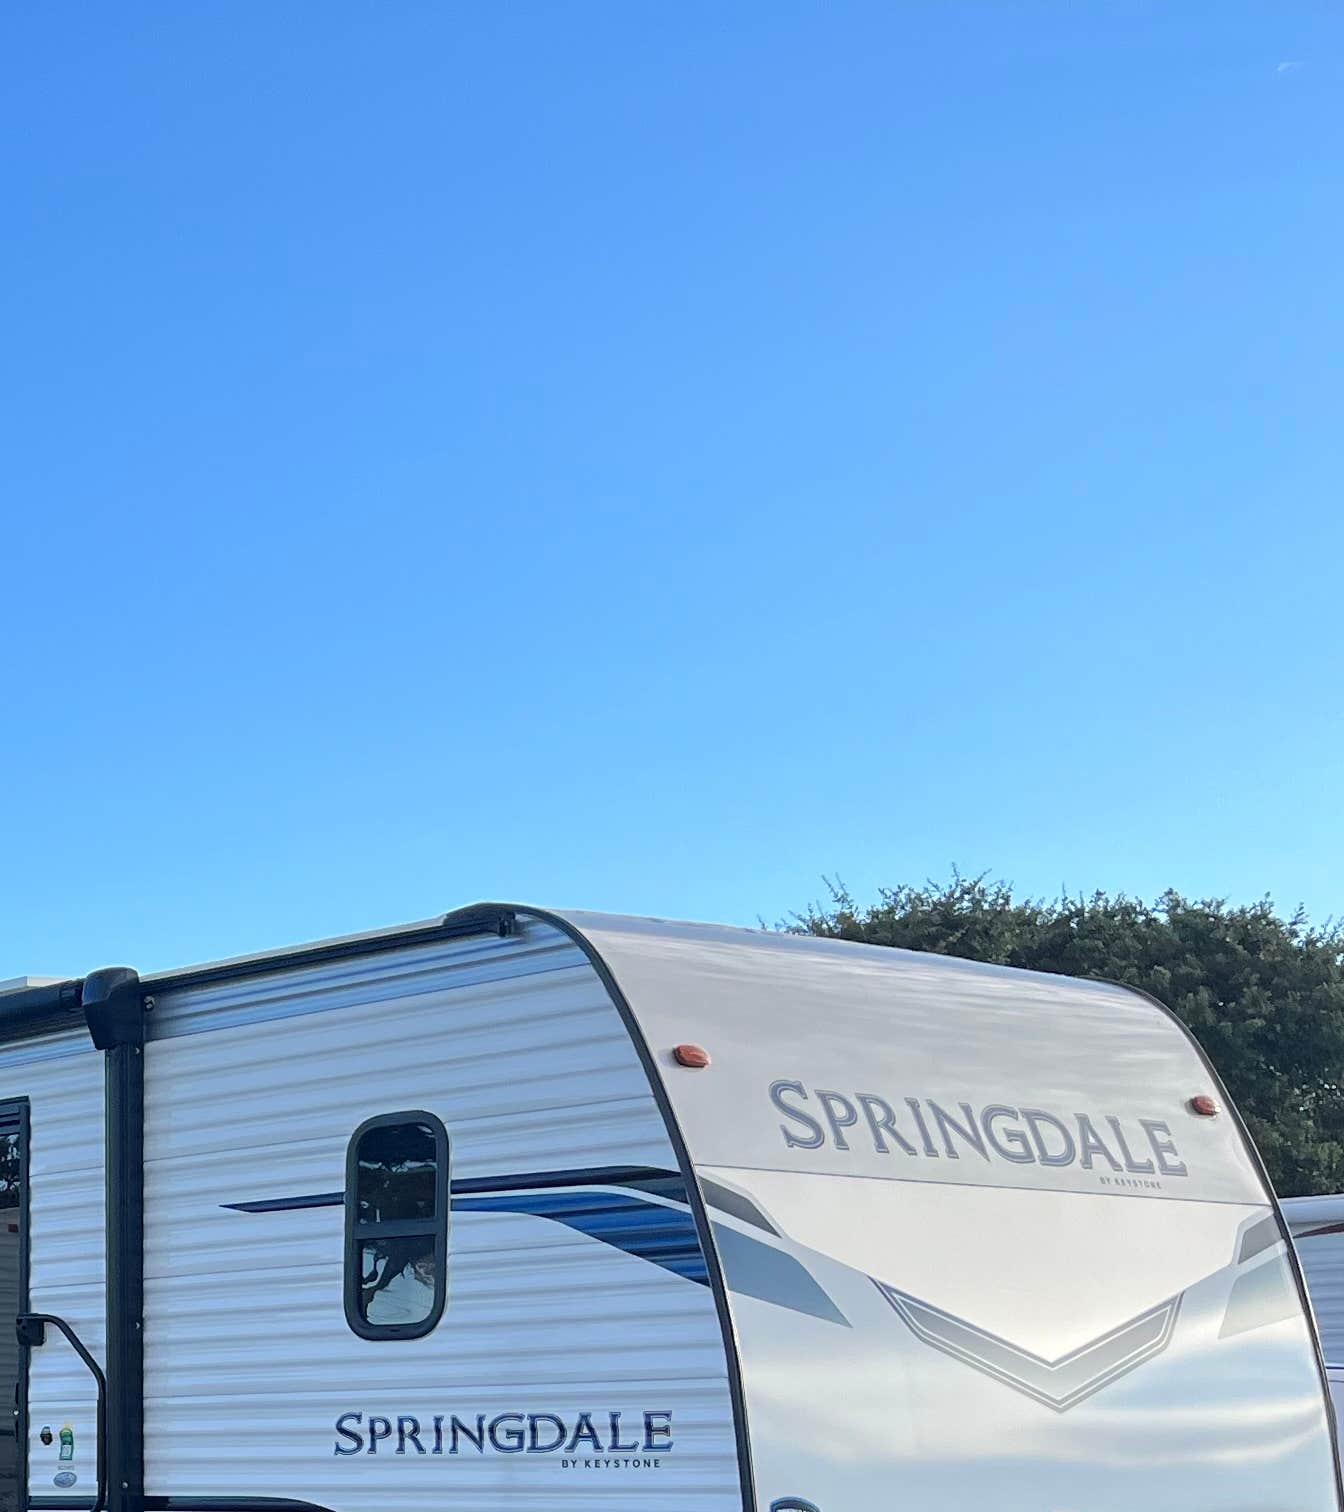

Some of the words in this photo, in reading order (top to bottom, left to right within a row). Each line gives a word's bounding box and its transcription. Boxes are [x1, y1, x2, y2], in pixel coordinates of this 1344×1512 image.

[768, 1079, 1189, 1176] SPRINGDALE
[334, 1410, 674, 1456] SPRINGDALE
[562, 1459, 577, 1469] BY
[584, 1458, 661, 1469] KEYSTONE
